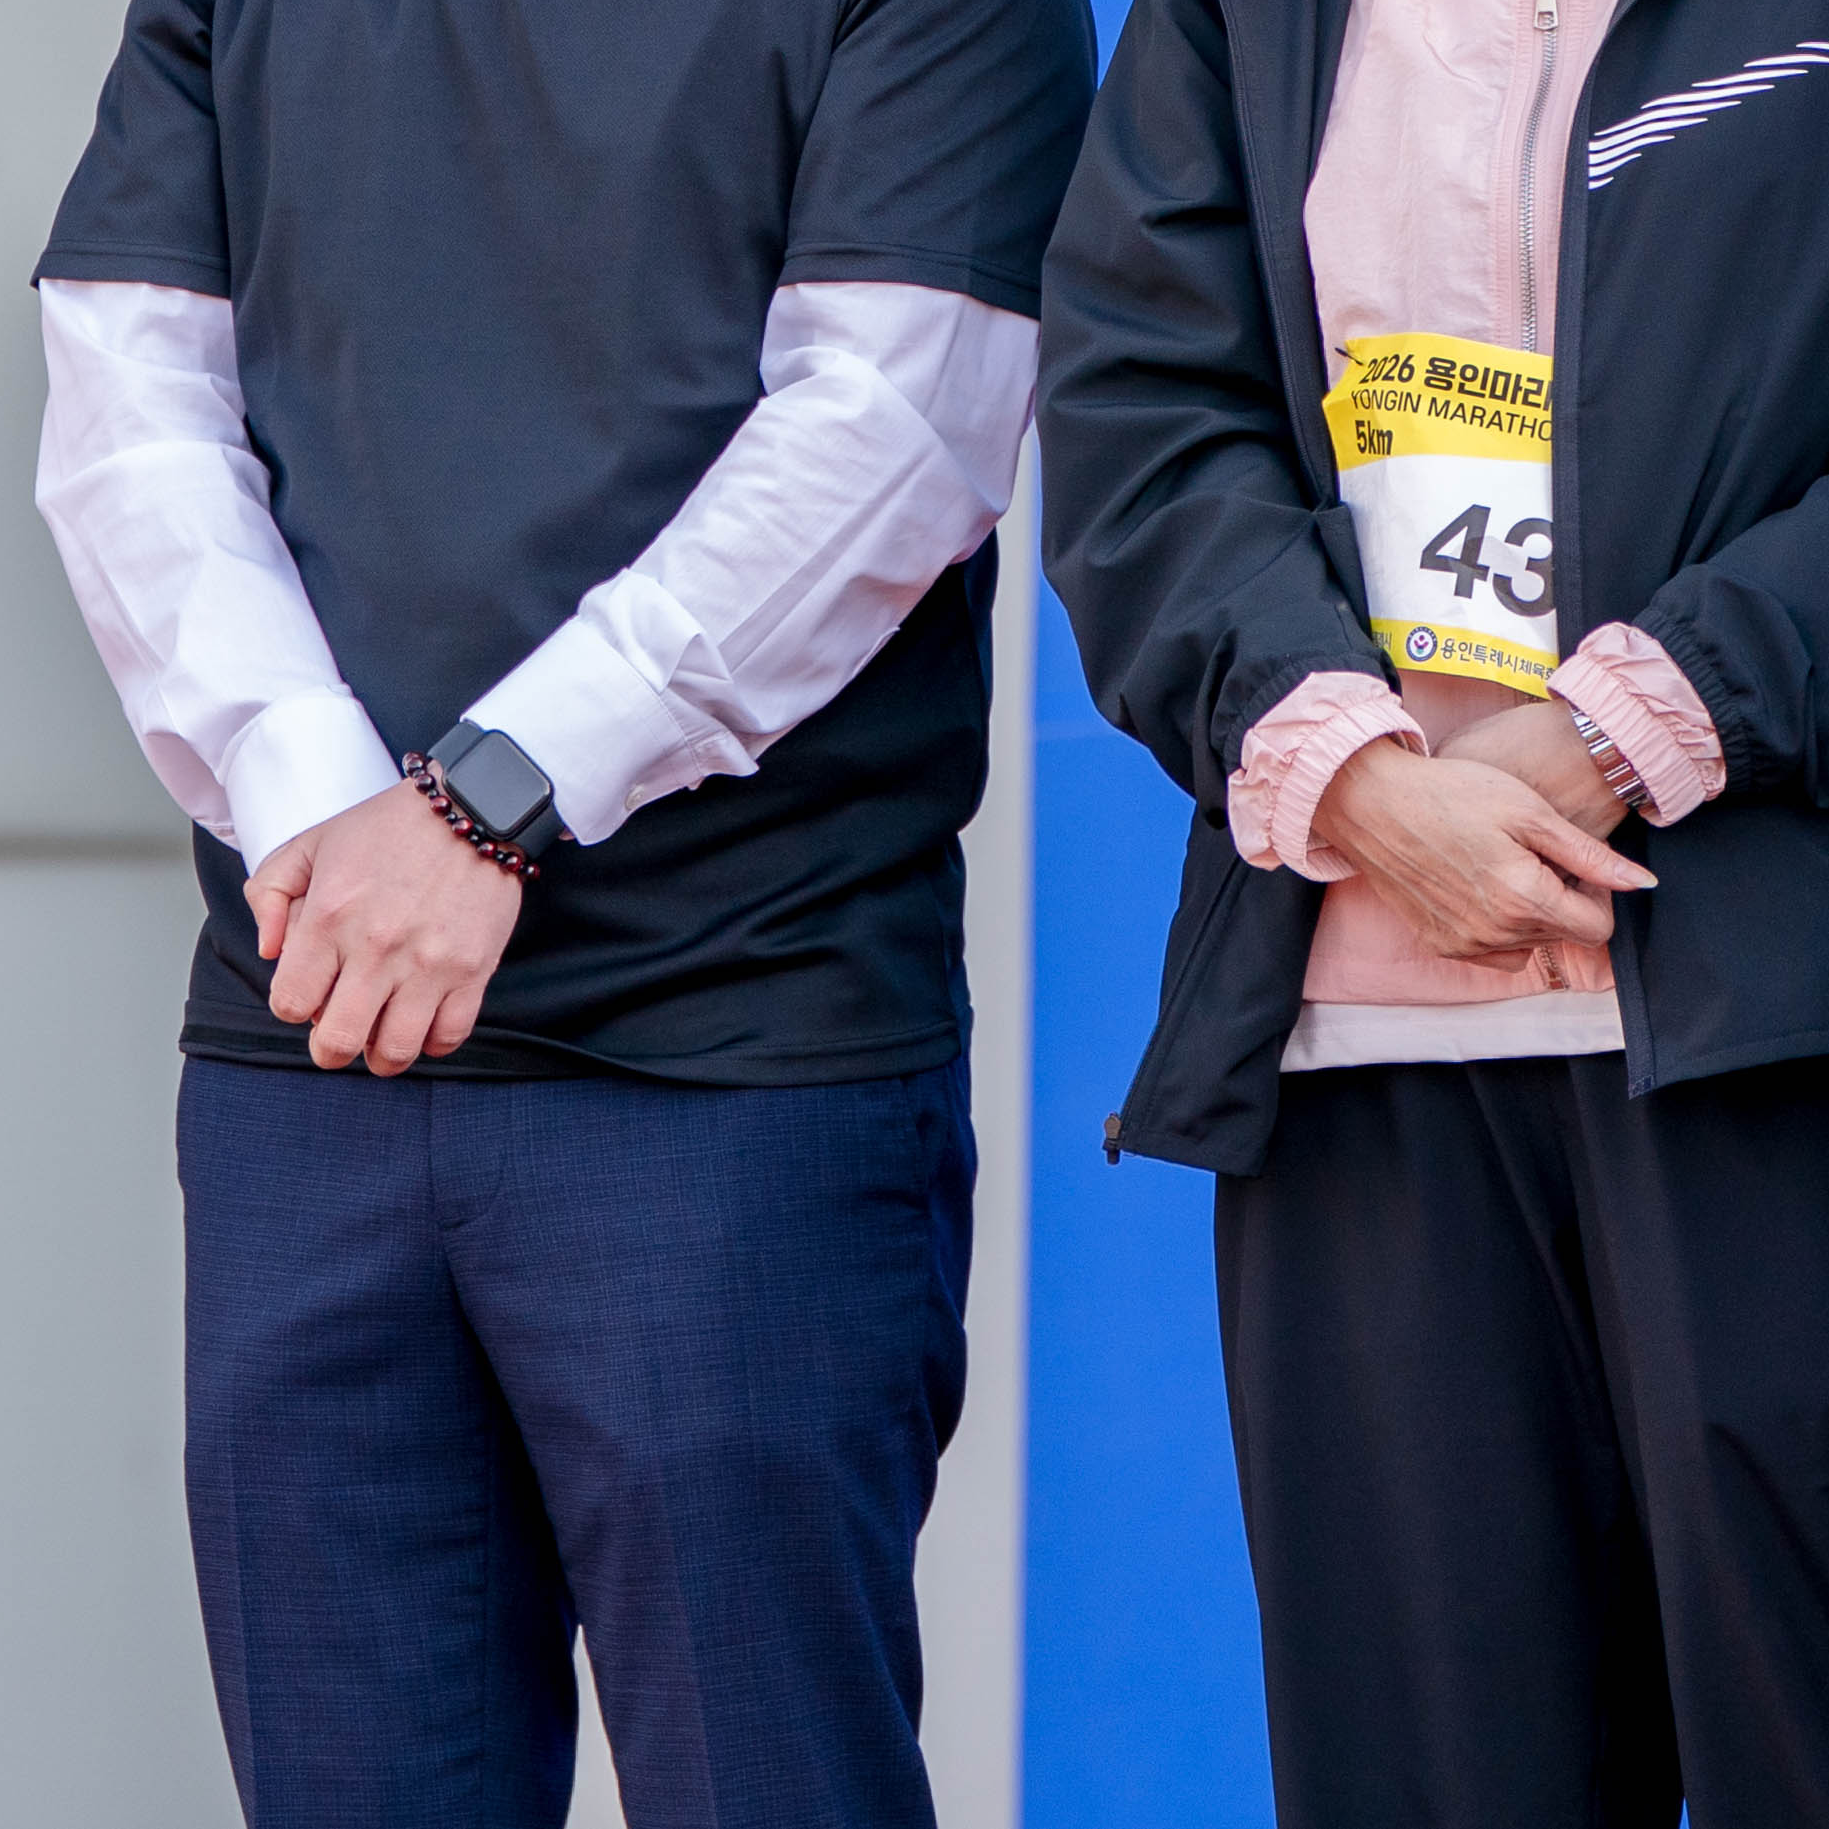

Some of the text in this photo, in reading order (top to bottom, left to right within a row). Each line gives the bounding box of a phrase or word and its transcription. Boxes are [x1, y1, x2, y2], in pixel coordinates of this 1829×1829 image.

[1358, 353, 1416, 384] 2026
[1350, 388, 1422, 414] YONGIN
[1354, 419, 1394, 456] 5km
[1419, 503, 1556, 618] 43
